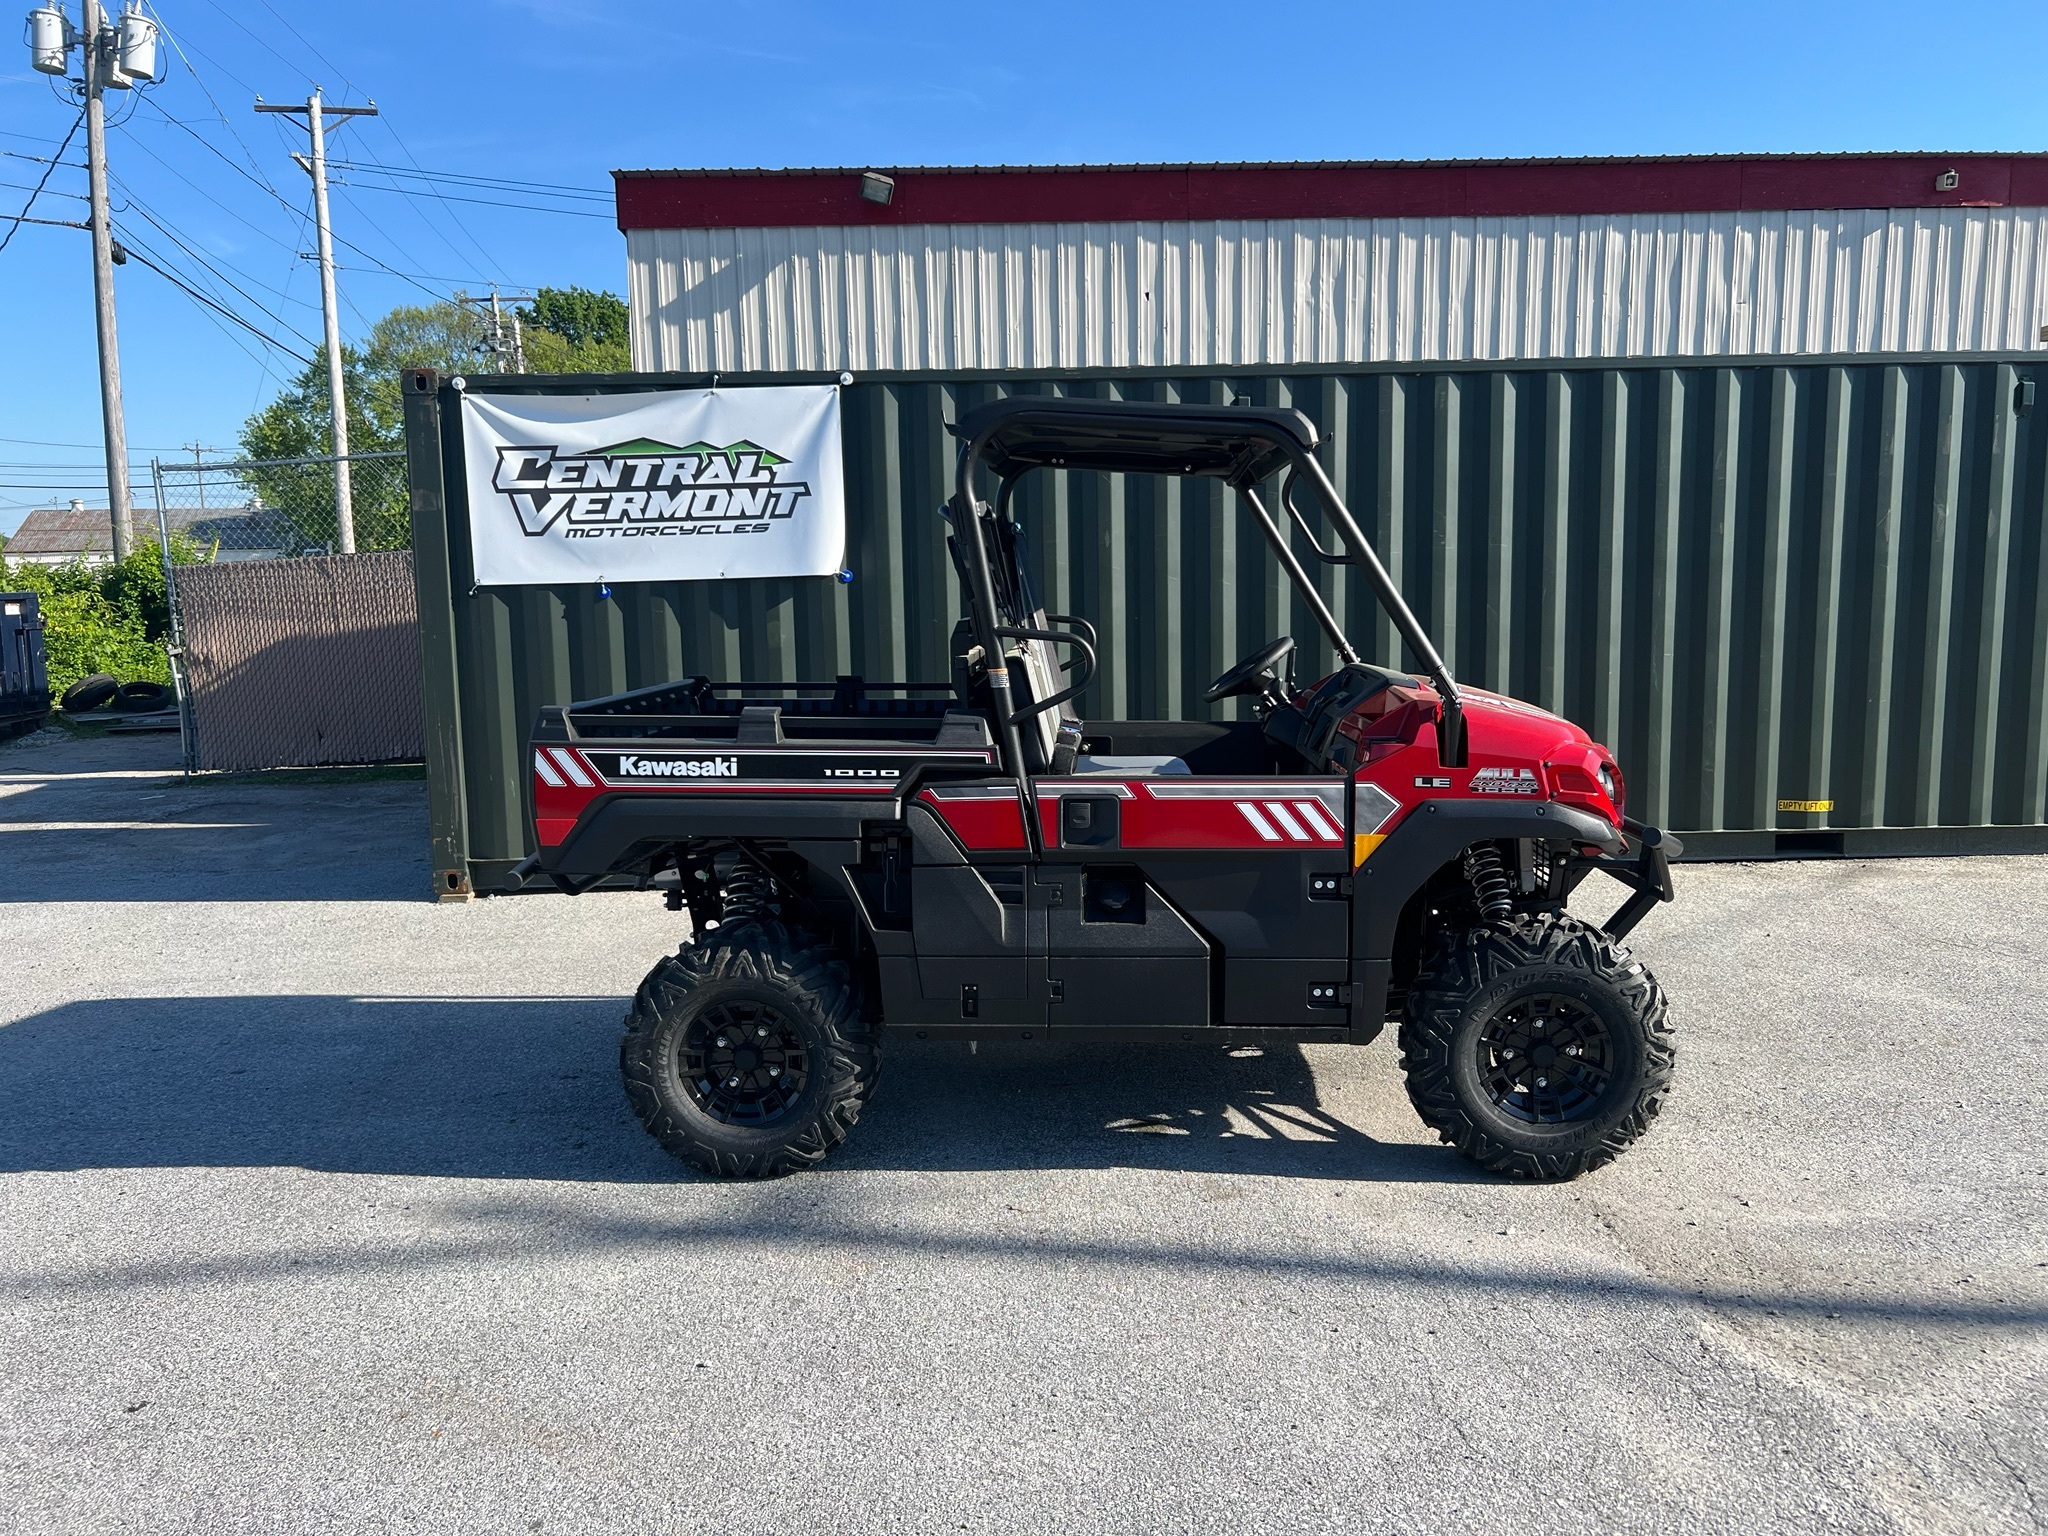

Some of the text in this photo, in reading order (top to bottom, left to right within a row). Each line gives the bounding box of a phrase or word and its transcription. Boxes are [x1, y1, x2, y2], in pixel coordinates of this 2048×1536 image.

[494, 446, 775, 491] CENTRAL
[510, 475, 810, 536] VERMONT
[564, 523, 770, 539] MOTORCYCLES
[619, 756, 737, 776] Kawasaki
[824, 769, 899, 777] 1000
[1473, 768, 1536, 780] MULE
[1415, 777, 1450, 787] LE
[1778, 801, 1803, 810] EMPTY
[1803, 802, 1818, 811] LIFT
